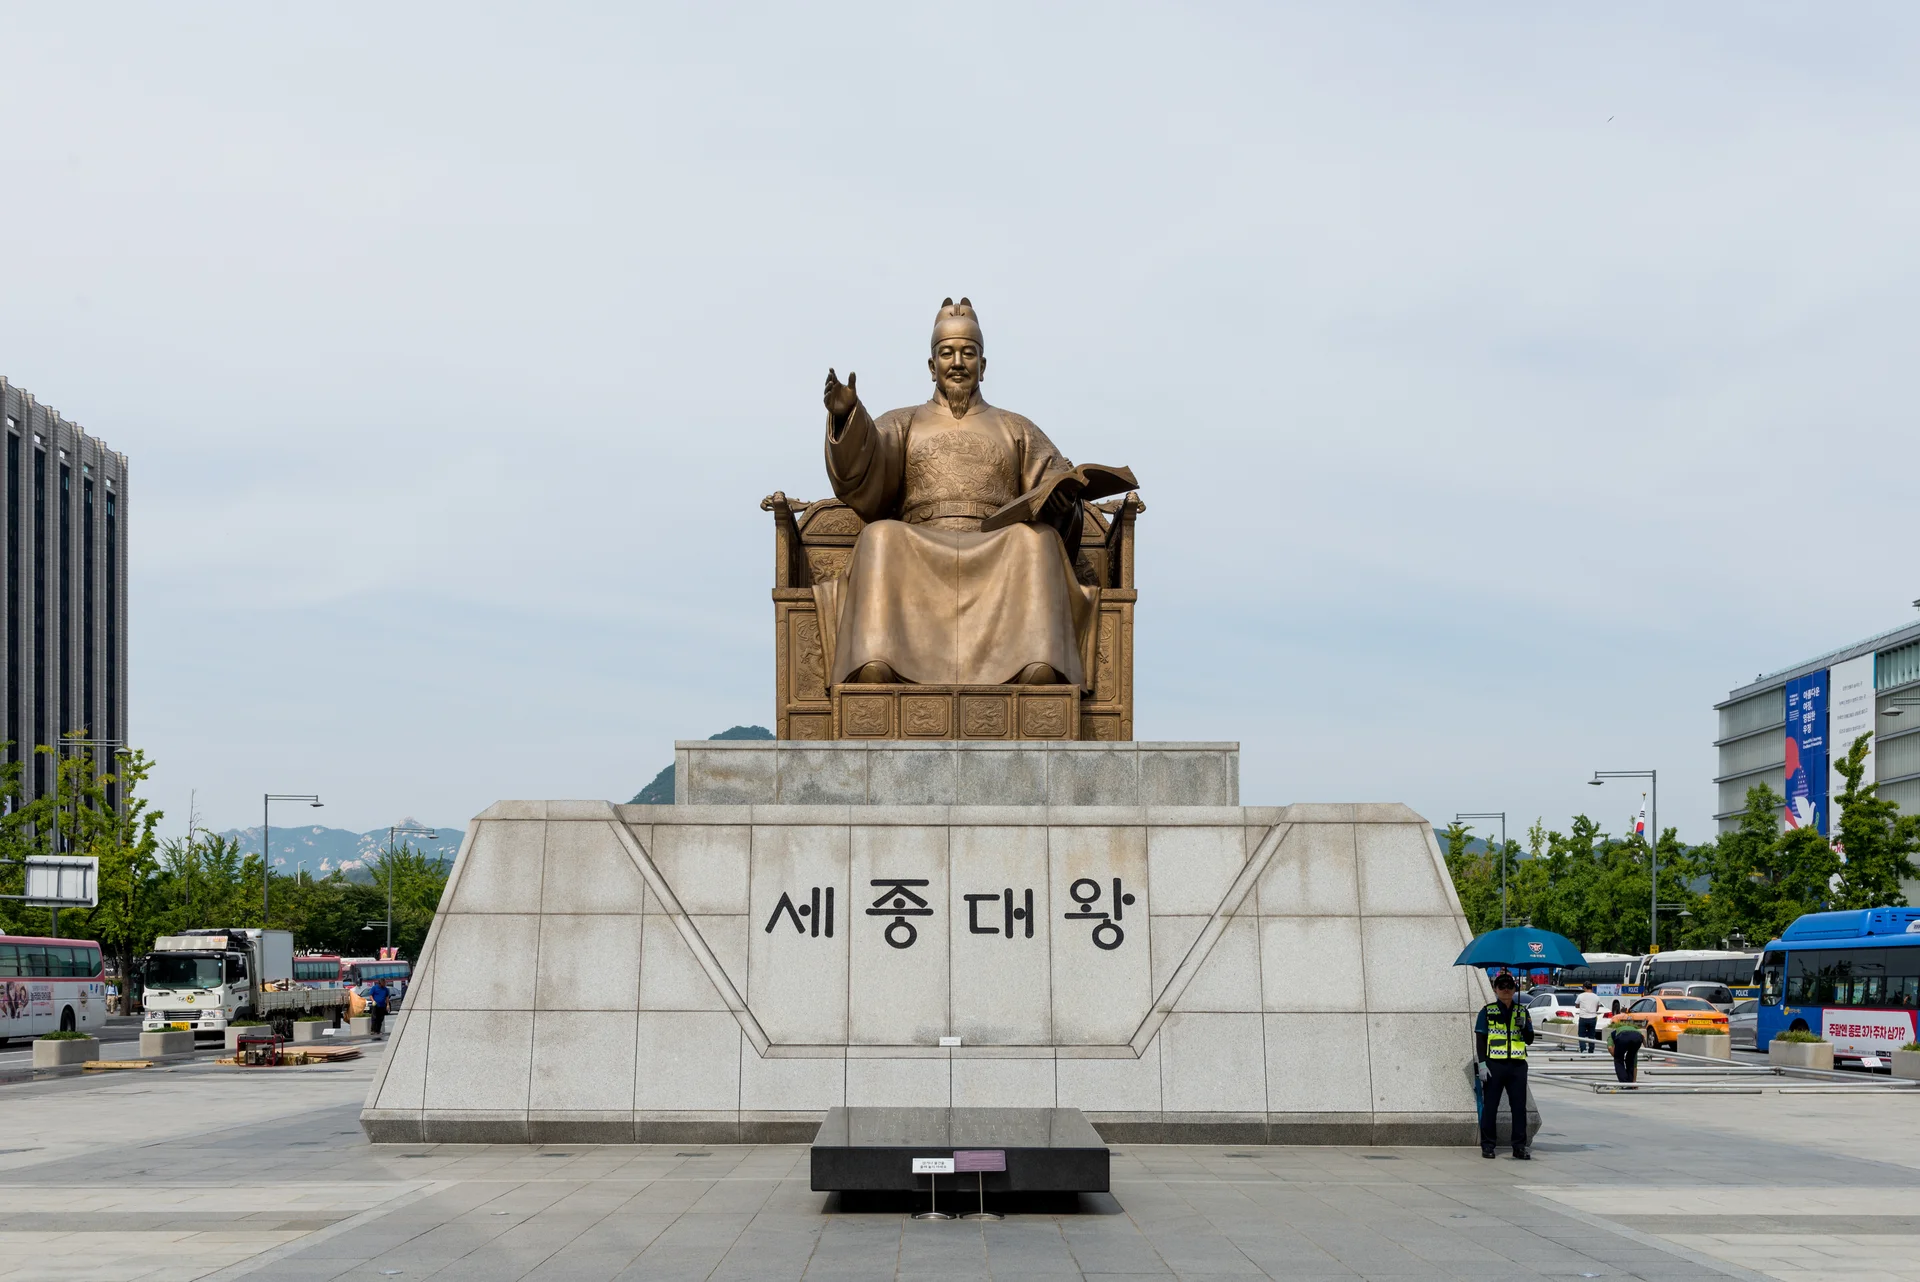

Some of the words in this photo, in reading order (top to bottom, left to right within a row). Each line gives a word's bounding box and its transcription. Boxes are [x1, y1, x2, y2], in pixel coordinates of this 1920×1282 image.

[1803, 687, 1820, 700] 아름다운
[1803, 723, 1811, 734] 우정
[765, 877, 1136, 950] 세종대왕
[1735, 989, 1749, 997] POLICE
[1829, 1023, 1847, 1037] 주말엔
[1848, 1024, 1861, 1038] 종로
[1862, 1025, 1872, 1038] 3가
[1873, 1026, 1886, 1039] 주차
